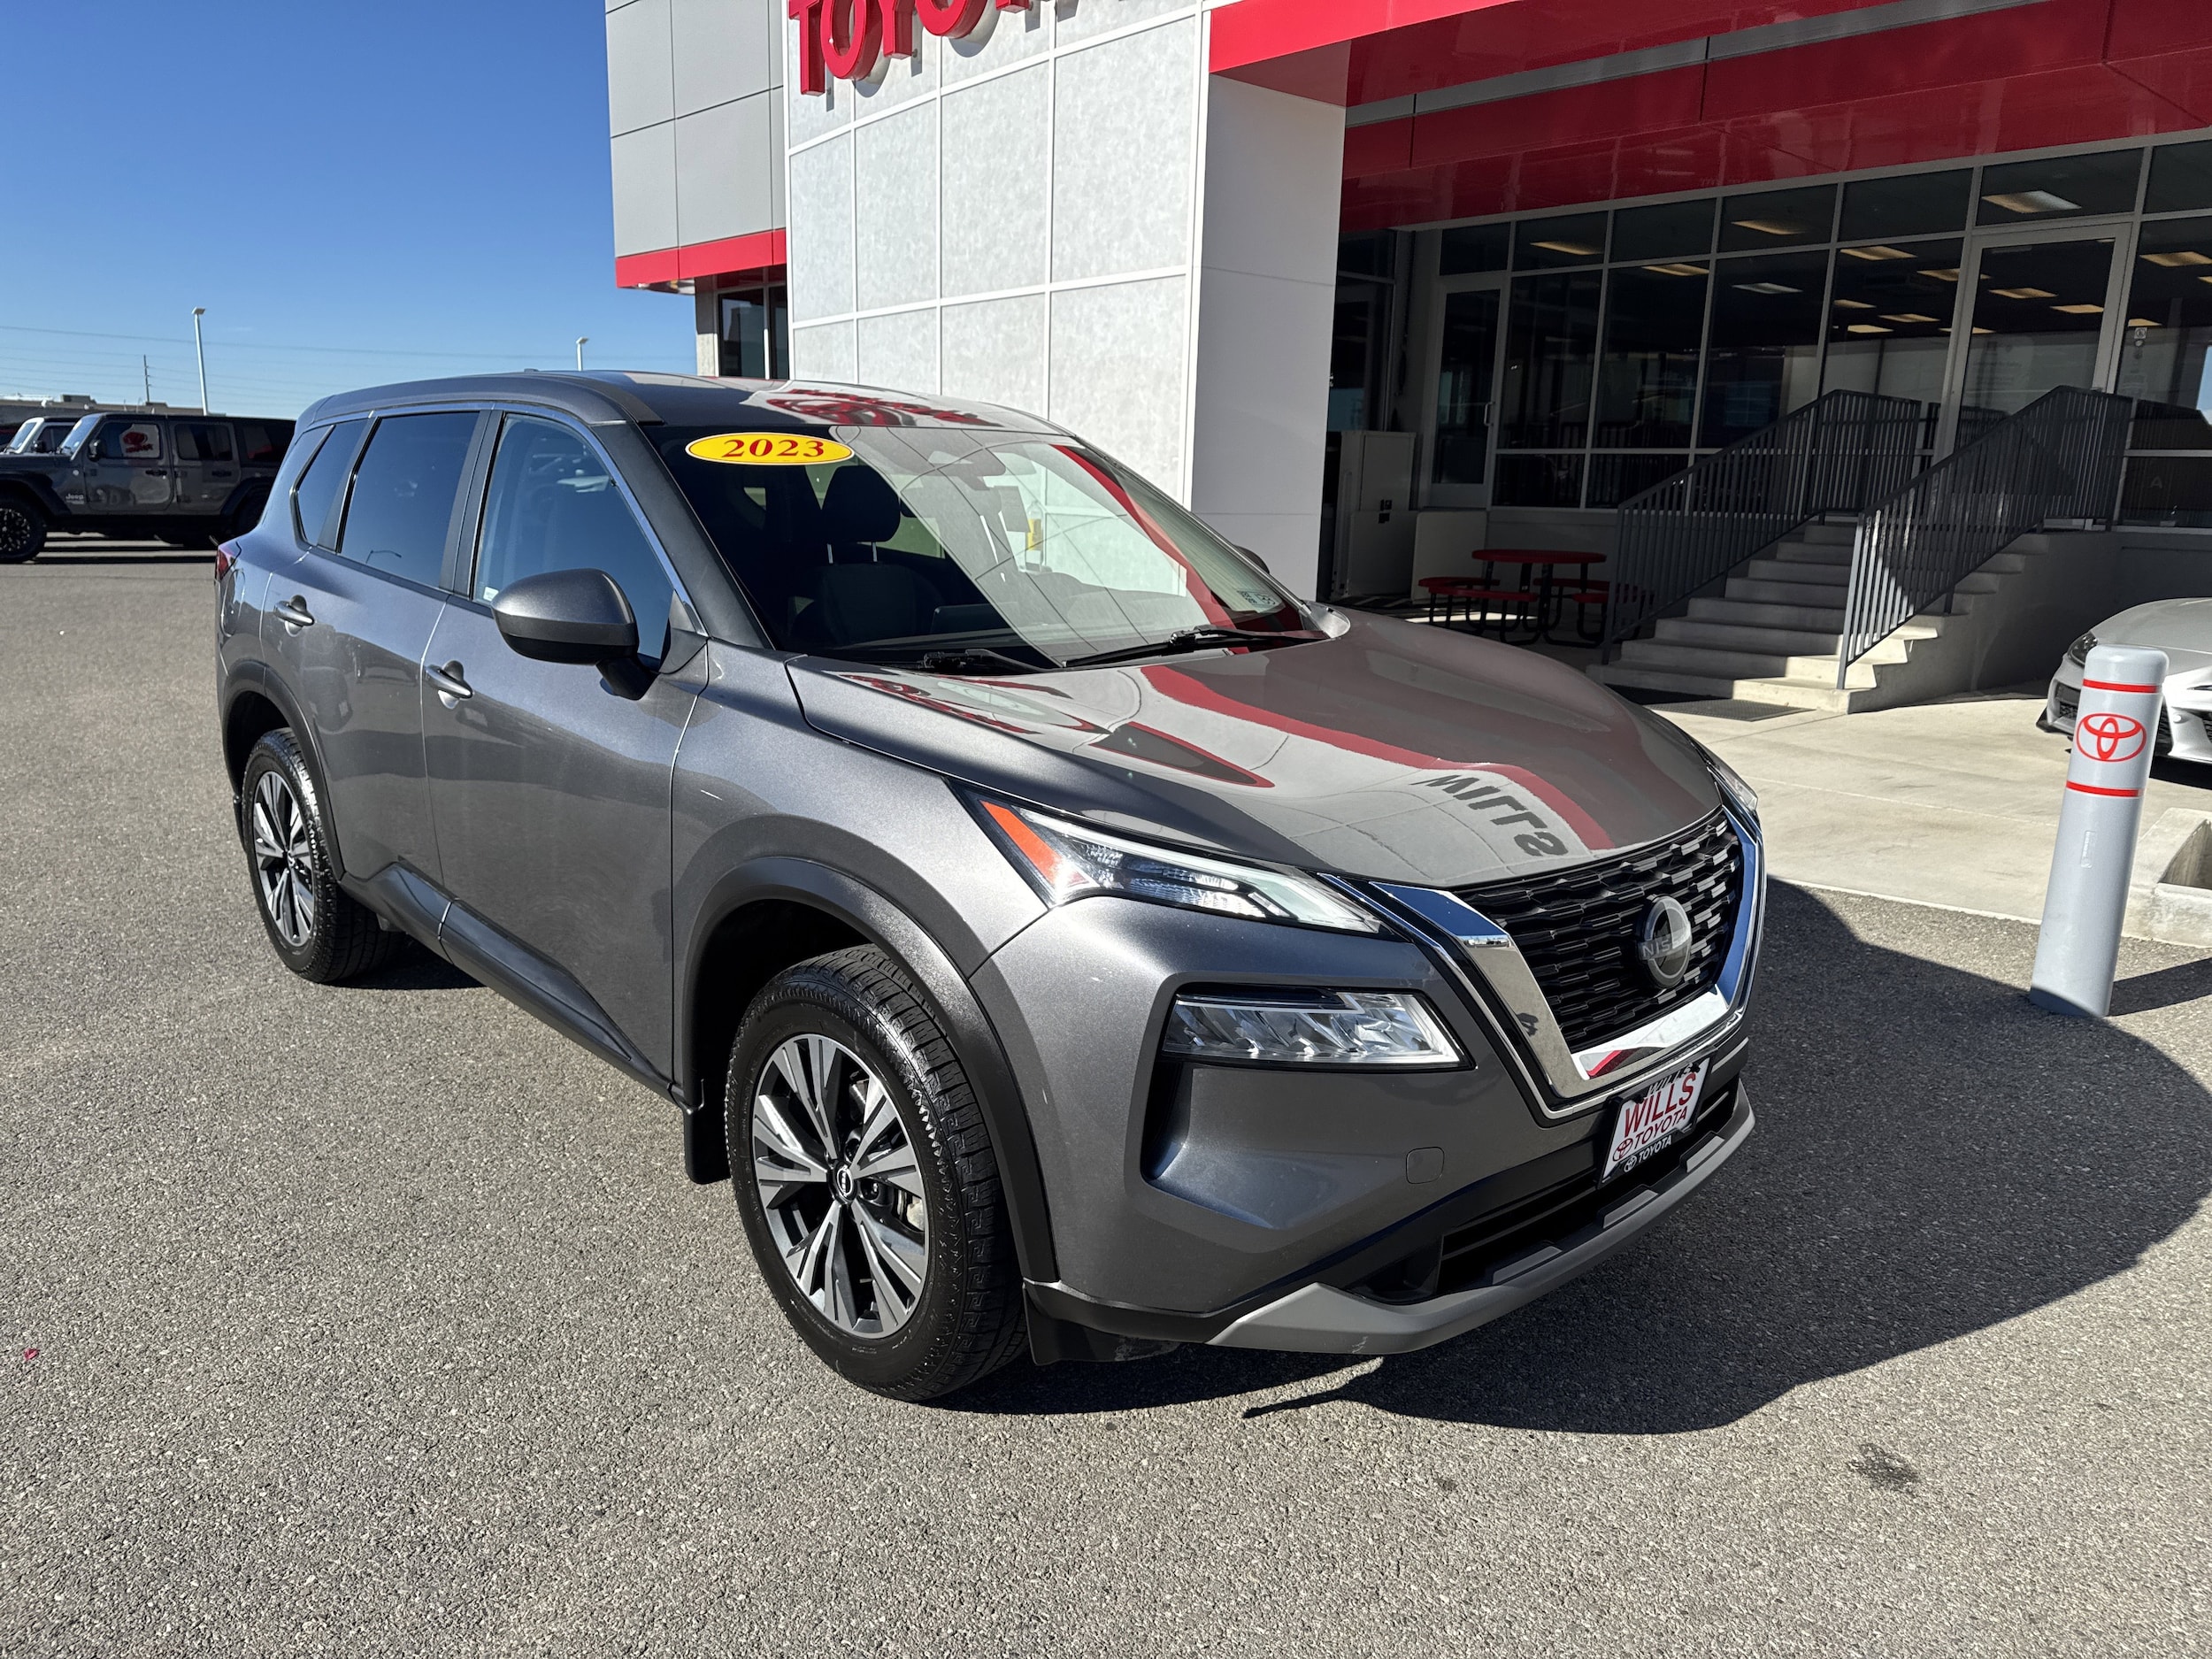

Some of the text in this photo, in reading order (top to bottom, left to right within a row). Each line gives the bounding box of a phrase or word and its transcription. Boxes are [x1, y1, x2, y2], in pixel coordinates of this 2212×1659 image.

[722, 439, 824, 457] 2023
[1624, 1072, 1696, 1138] WILLS
[1636, 1107, 1688, 1149] TOYOTA
[1639, 1135, 1671, 1164] TOYOTA
